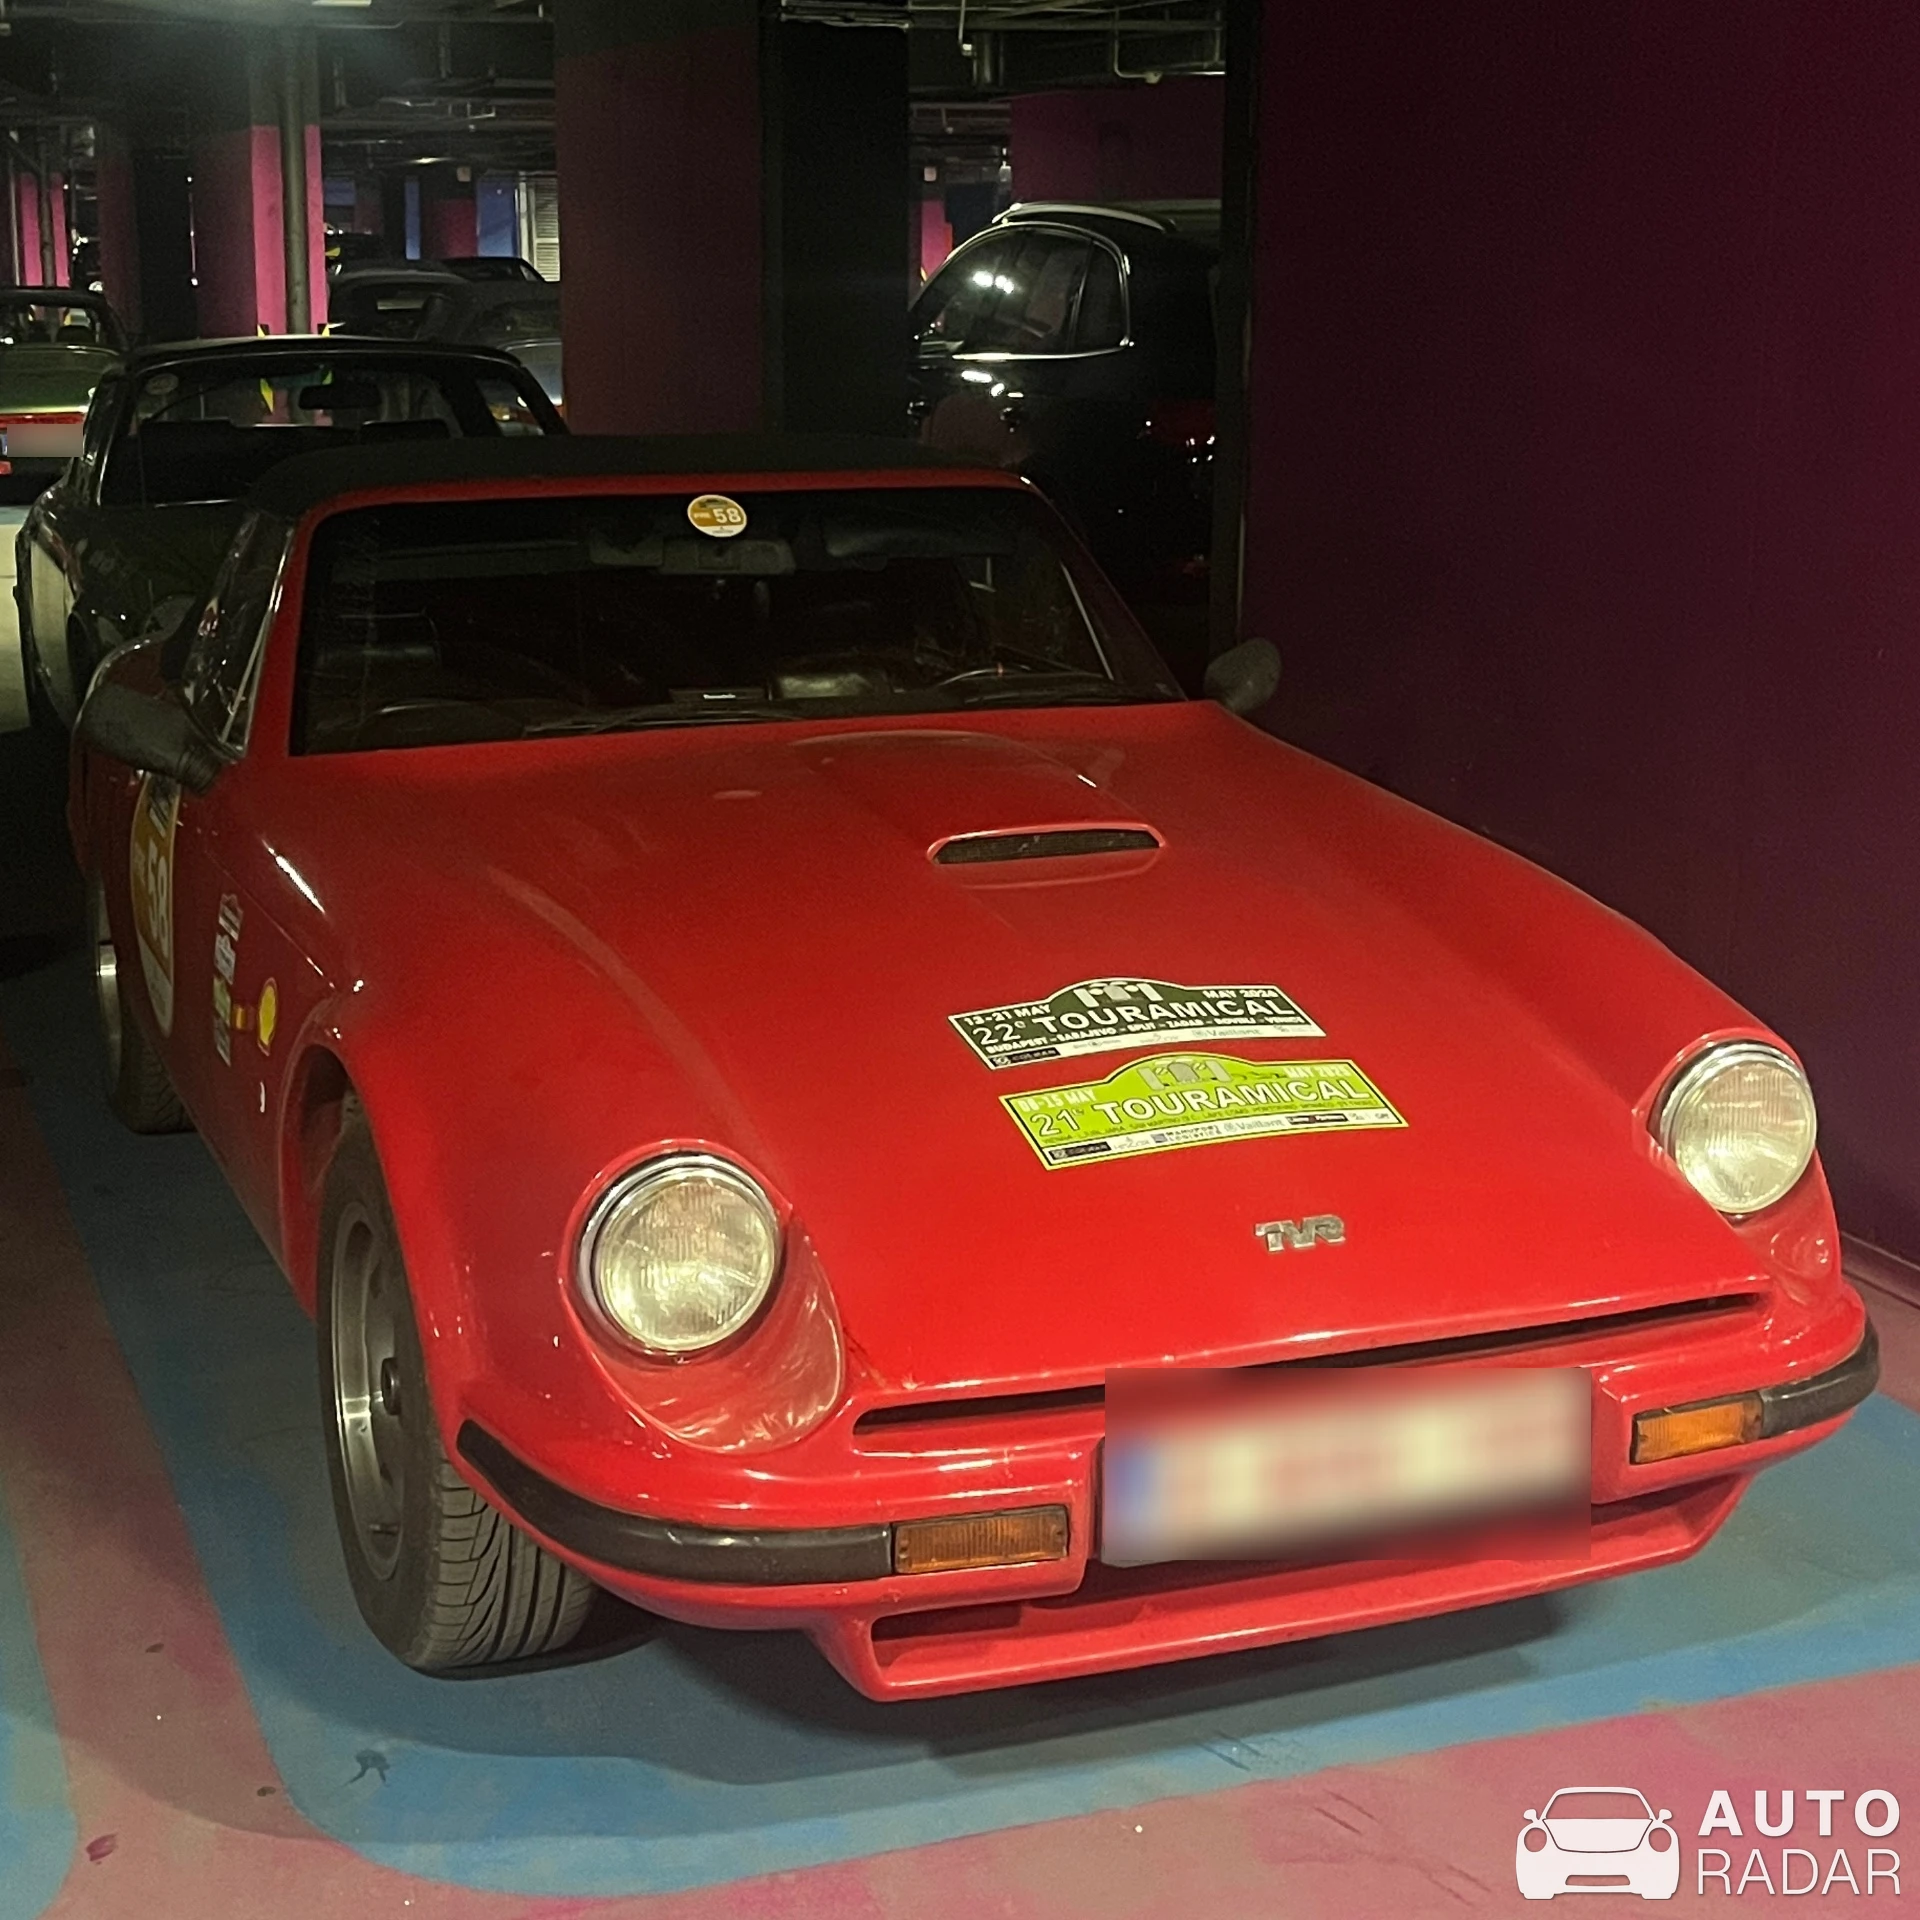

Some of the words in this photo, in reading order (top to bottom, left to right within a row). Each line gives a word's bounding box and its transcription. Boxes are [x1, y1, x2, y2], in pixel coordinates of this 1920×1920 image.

[712, 508, 742, 524] 58
[1202, 990, 1237, 999] MAY
[1014, 1004, 1051, 1018] MAY
[1032, 999, 1296, 1034] TOURAMICAL
[984, 1037, 1049, 1054] BUDAPEST
[1057, 1027, 1117, 1042] SARAJEVO
[1127, 1022, 1157, 1033] SPLIT
[1206, 1027, 1263, 1037] Vaillant
[1283, 1066, 1315, 1079] MAY
[1064, 1088, 1097, 1104] MAY
[1091, 1079, 1371, 1125] TOURAMICAL
[1236, 1118, 1286, 1130] Vaillant
[1254, 1213, 1346, 1252] TVR
